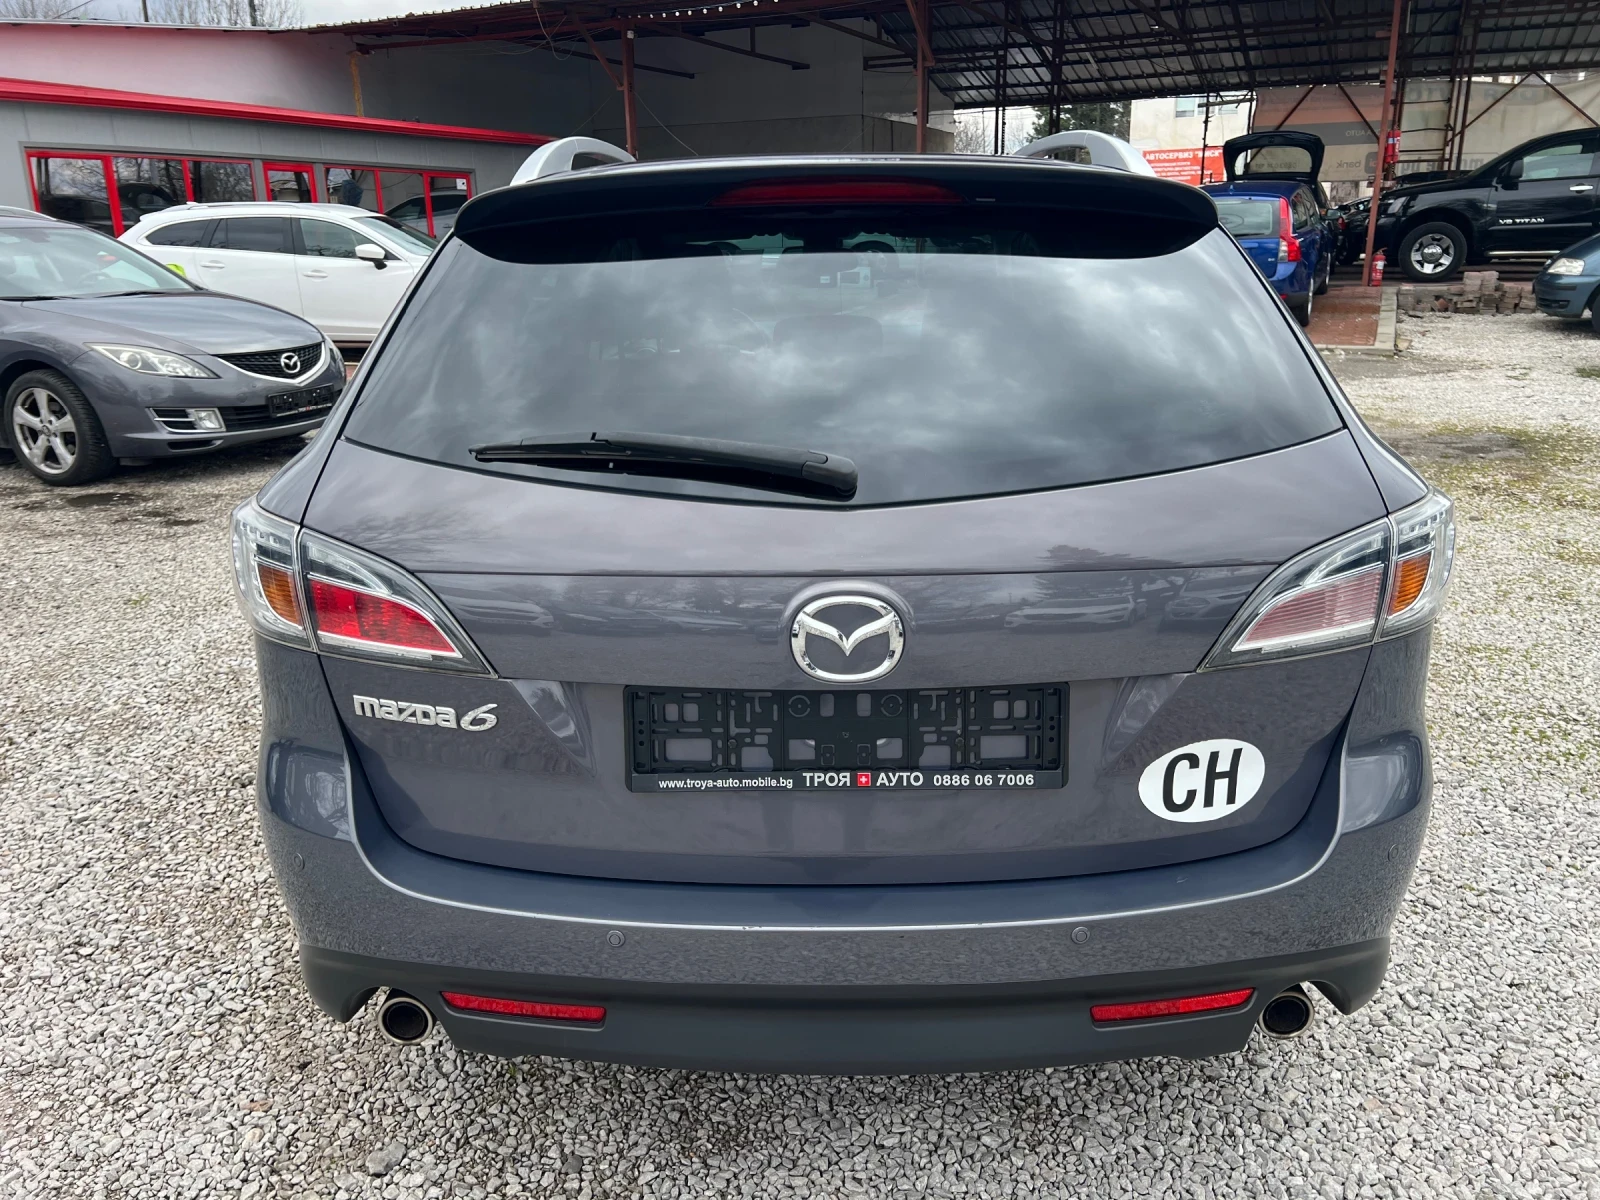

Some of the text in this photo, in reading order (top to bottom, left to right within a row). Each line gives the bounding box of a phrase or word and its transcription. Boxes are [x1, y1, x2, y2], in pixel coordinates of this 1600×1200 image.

[1145, 151, 1193, 160] АВТОСЕРВИЗ
[658, 771, 1035, 790] www.troya-auto.mobile.bg ТРОЯ АУТО 0886 06 7006
[1162, 747, 1243, 813] CH
